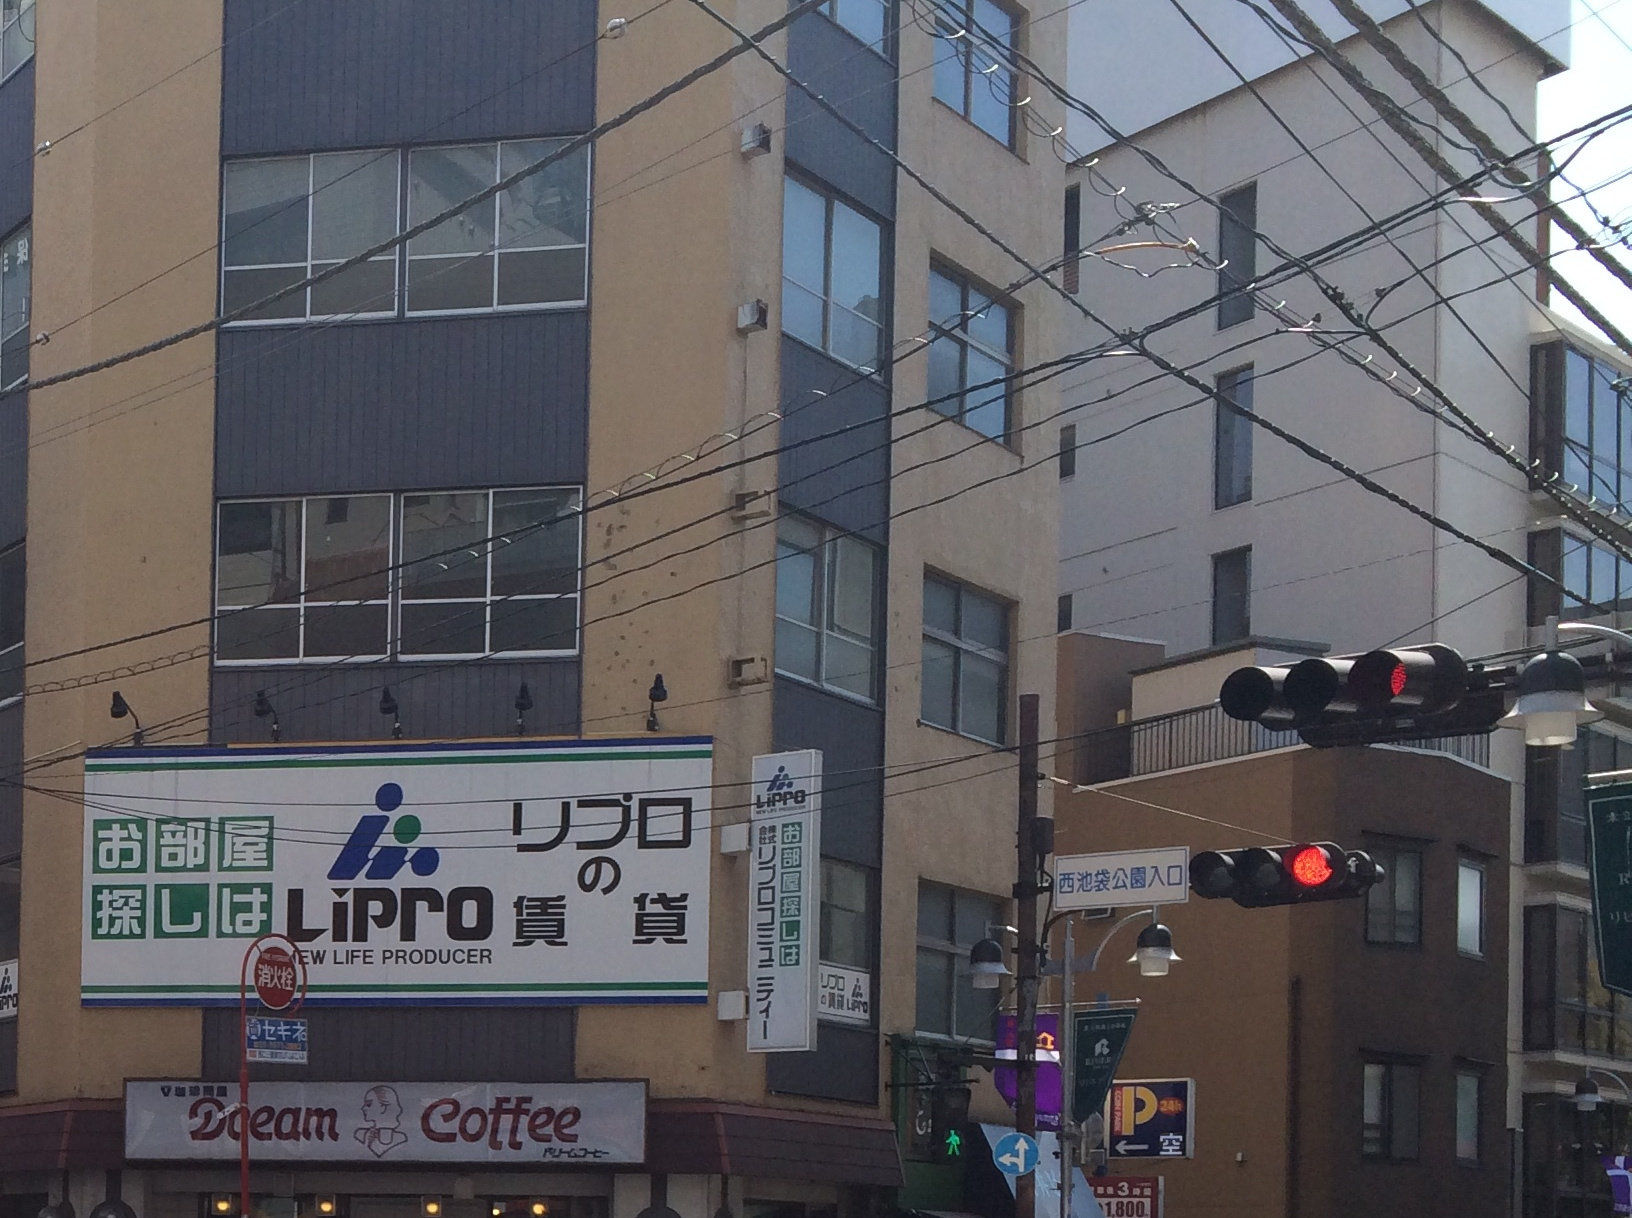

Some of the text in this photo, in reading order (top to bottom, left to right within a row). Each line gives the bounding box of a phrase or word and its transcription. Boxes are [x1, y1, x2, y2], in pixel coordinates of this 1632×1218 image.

[95, 818, 272, 870] お部屋
[577, 856, 622, 896] の
[1059, 865, 1183, 894] 西池袋公園入口
[95, 886, 270, 935] 探しは
[292, 949, 327, 965] EW
[333, 950, 375, 965] LIFE
[381, 948, 494, 965] PRODUCER
[258, 963, 294, 991] 消火栓
[188, 1096, 582, 1150] Dream Coffee
[1159, 1133, 1183, 1155] 空
